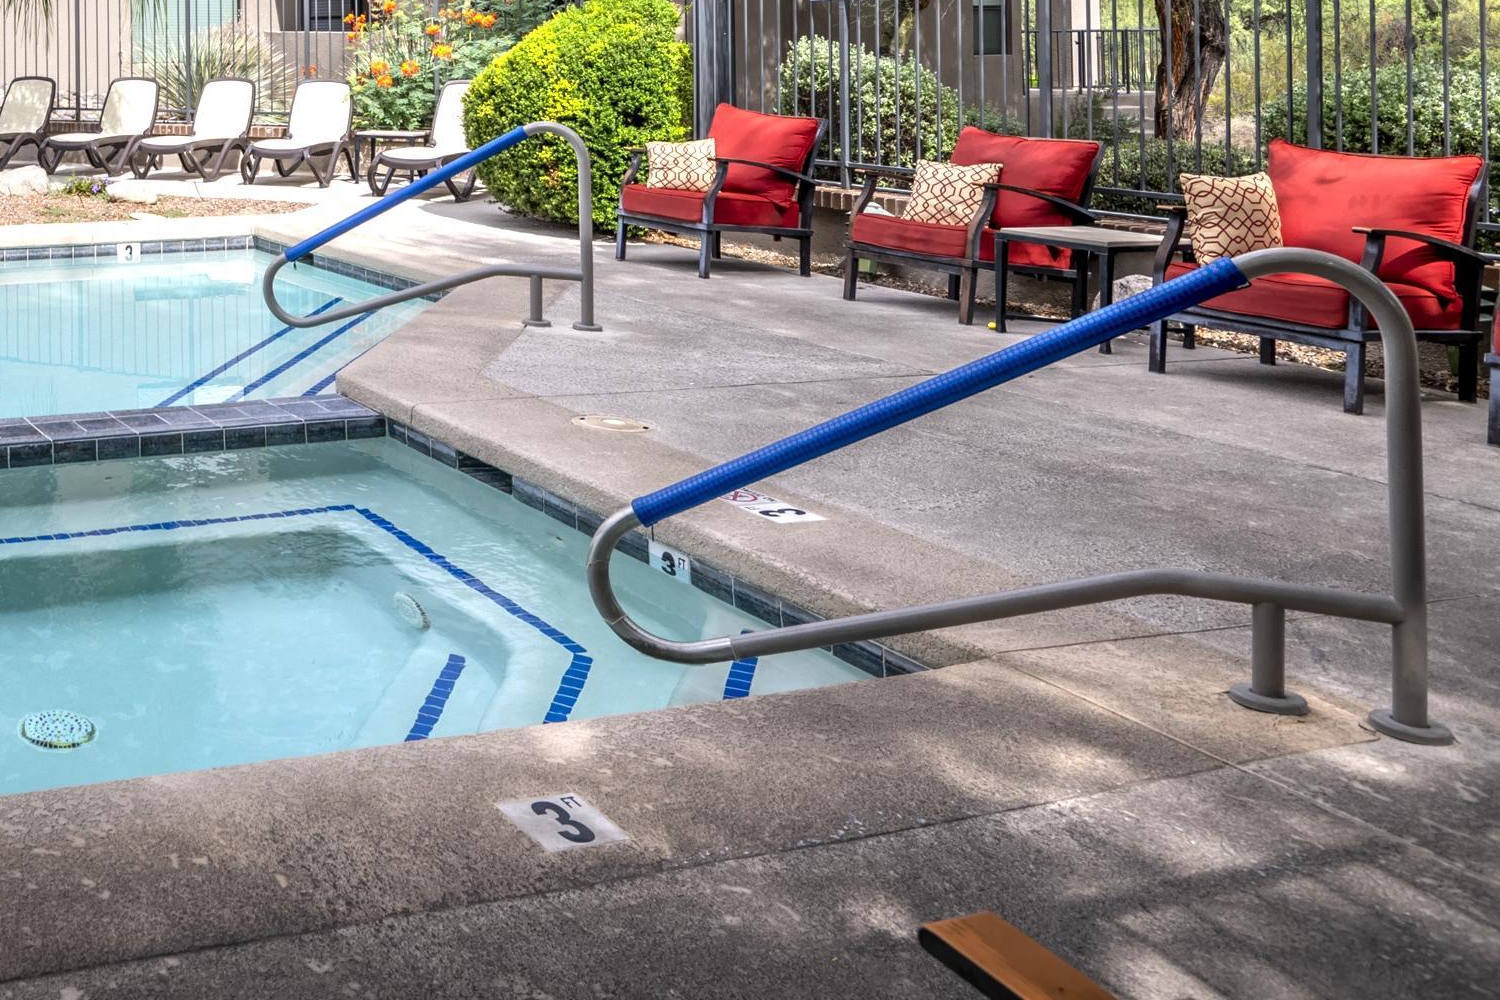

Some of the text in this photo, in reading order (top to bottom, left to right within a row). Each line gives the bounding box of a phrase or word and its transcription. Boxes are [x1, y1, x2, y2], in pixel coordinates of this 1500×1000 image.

[759, 508, 807, 517] 3
[661, 551, 686, 576] 3 FT
[531, 796, 595, 843] 3 FT
